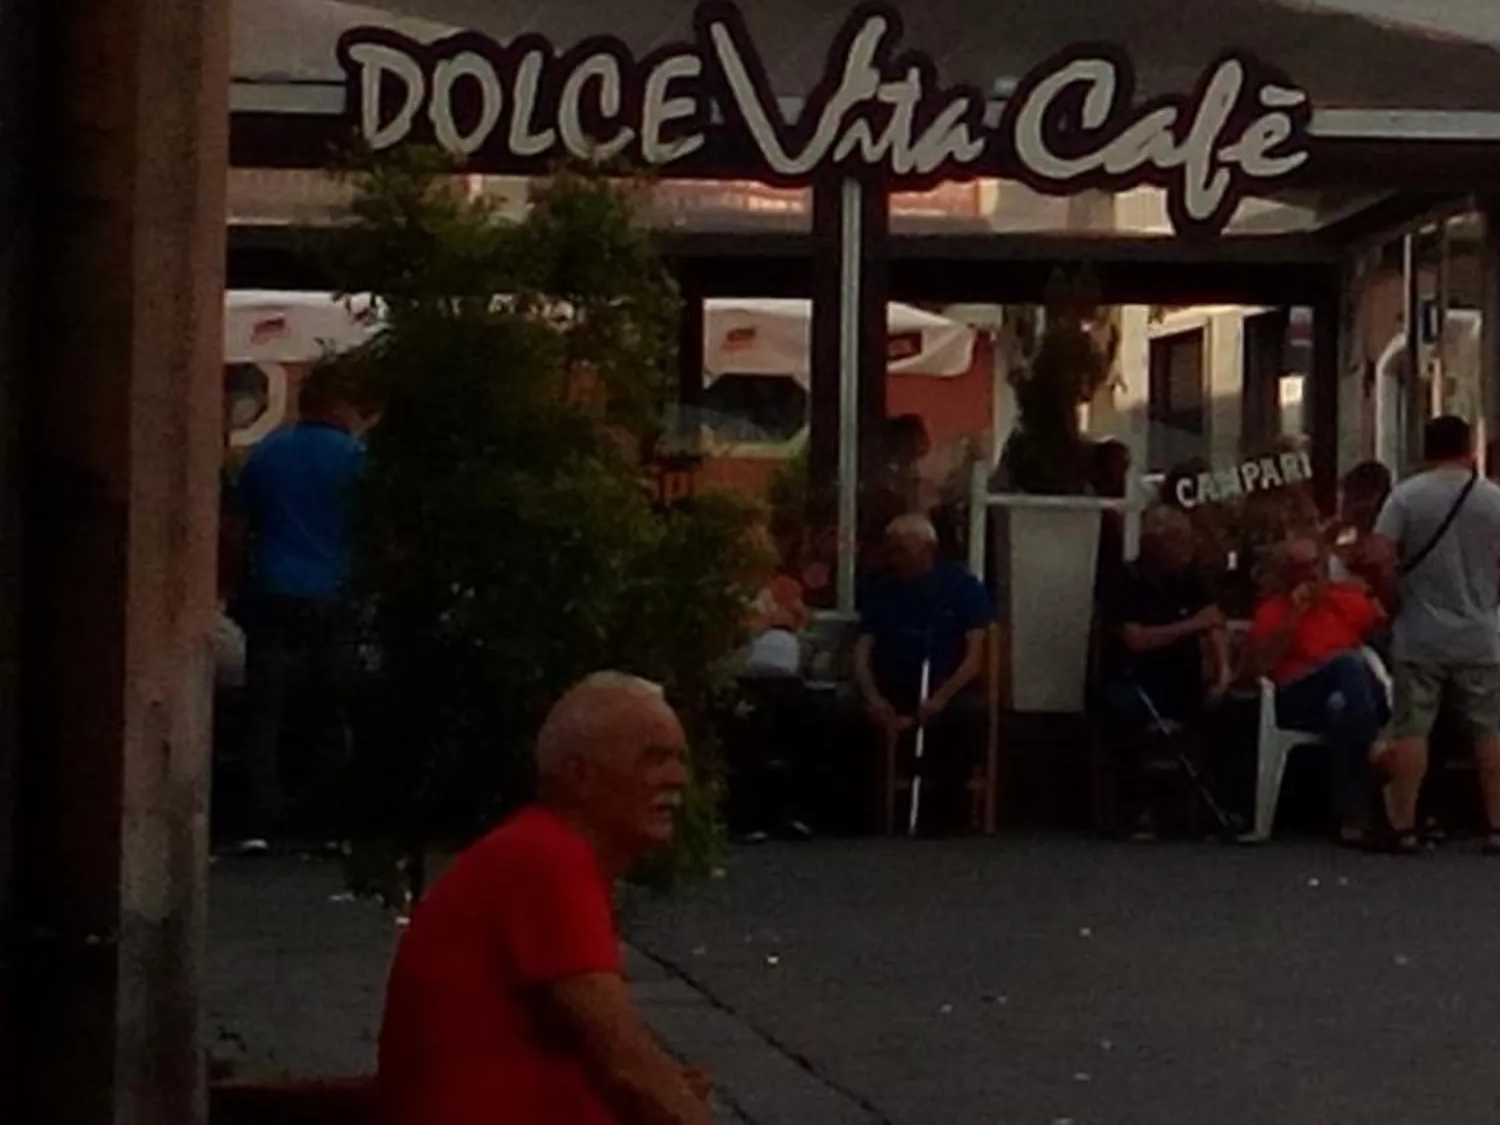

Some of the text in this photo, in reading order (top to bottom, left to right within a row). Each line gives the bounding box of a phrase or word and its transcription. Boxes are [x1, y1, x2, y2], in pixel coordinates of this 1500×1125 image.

[350, 43, 704, 164] DOLCE
[710, 16, 985, 174] Vita
[1175, 451, 1313, 508] CAMPARI
